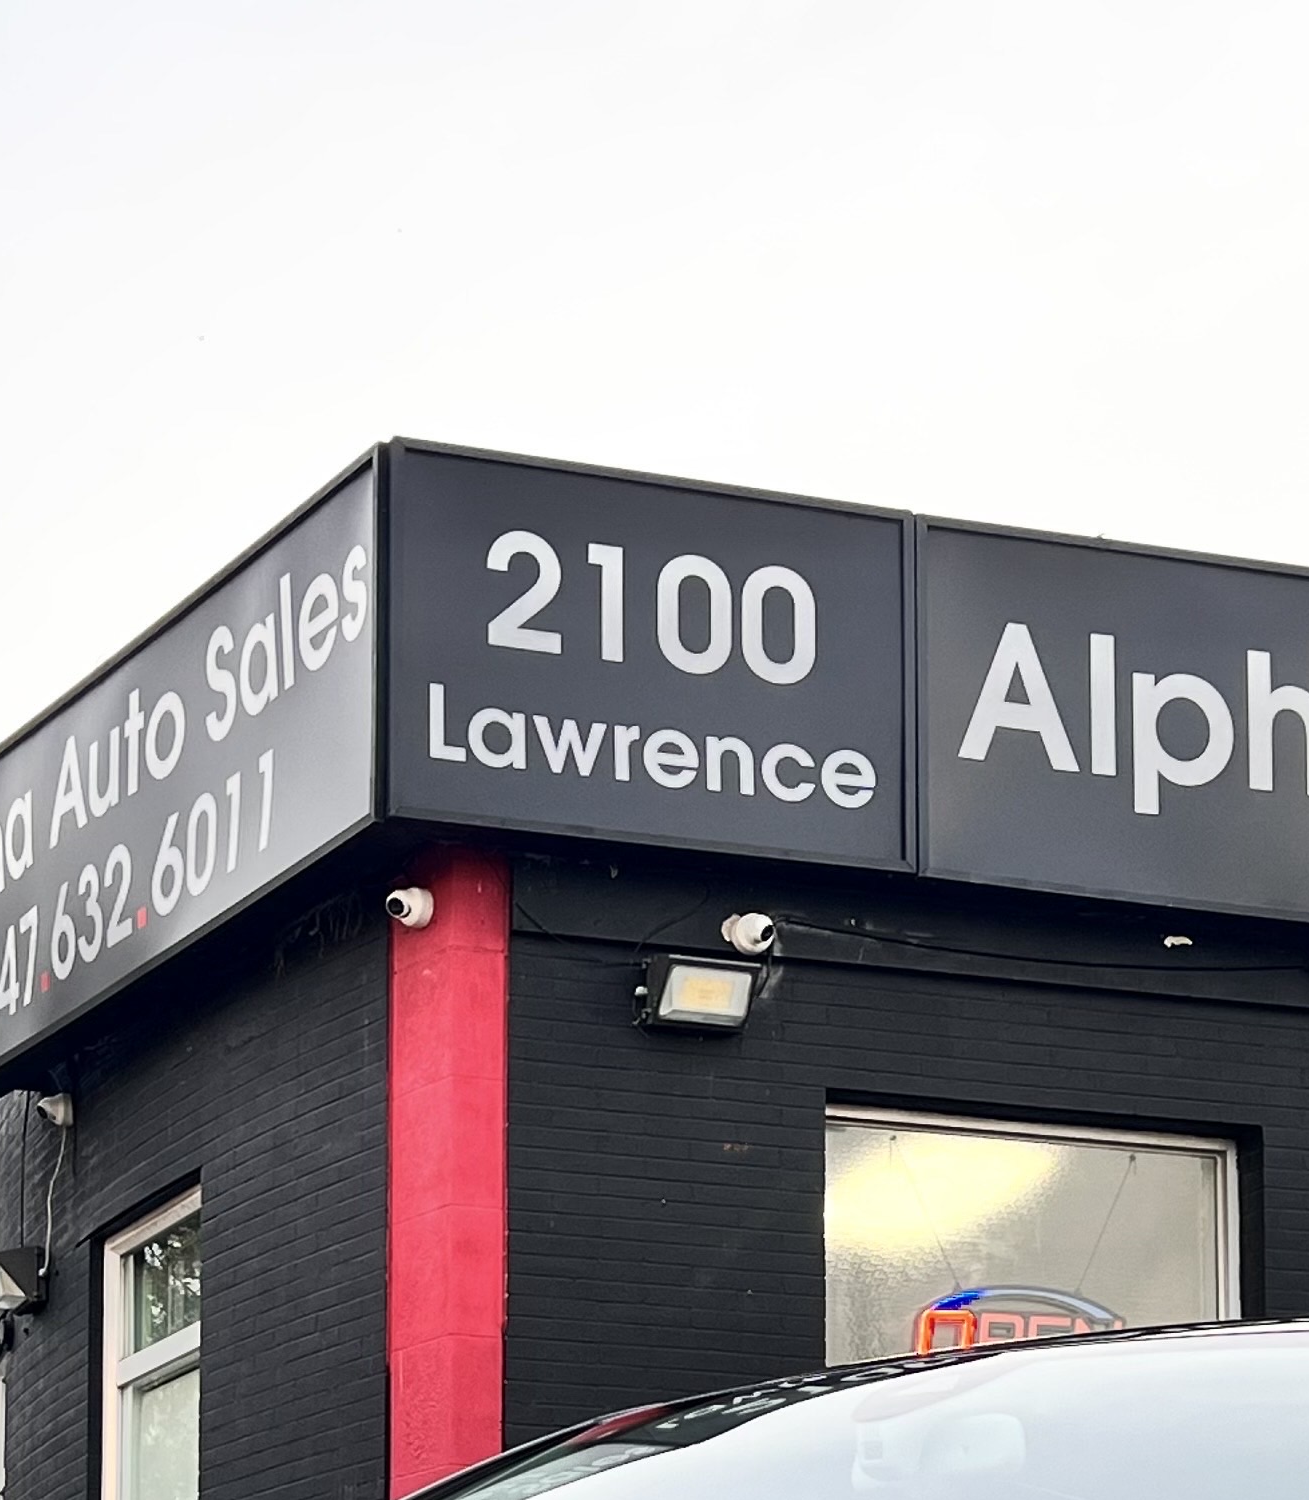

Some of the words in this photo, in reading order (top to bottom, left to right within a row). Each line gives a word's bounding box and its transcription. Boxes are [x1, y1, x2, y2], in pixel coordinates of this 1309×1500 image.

[486, 529, 817, 685] 2100
[49, 688, 186, 850] Auto
[205, 543, 369, 742] Sales
[427, 682, 878, 809] Lawrence
